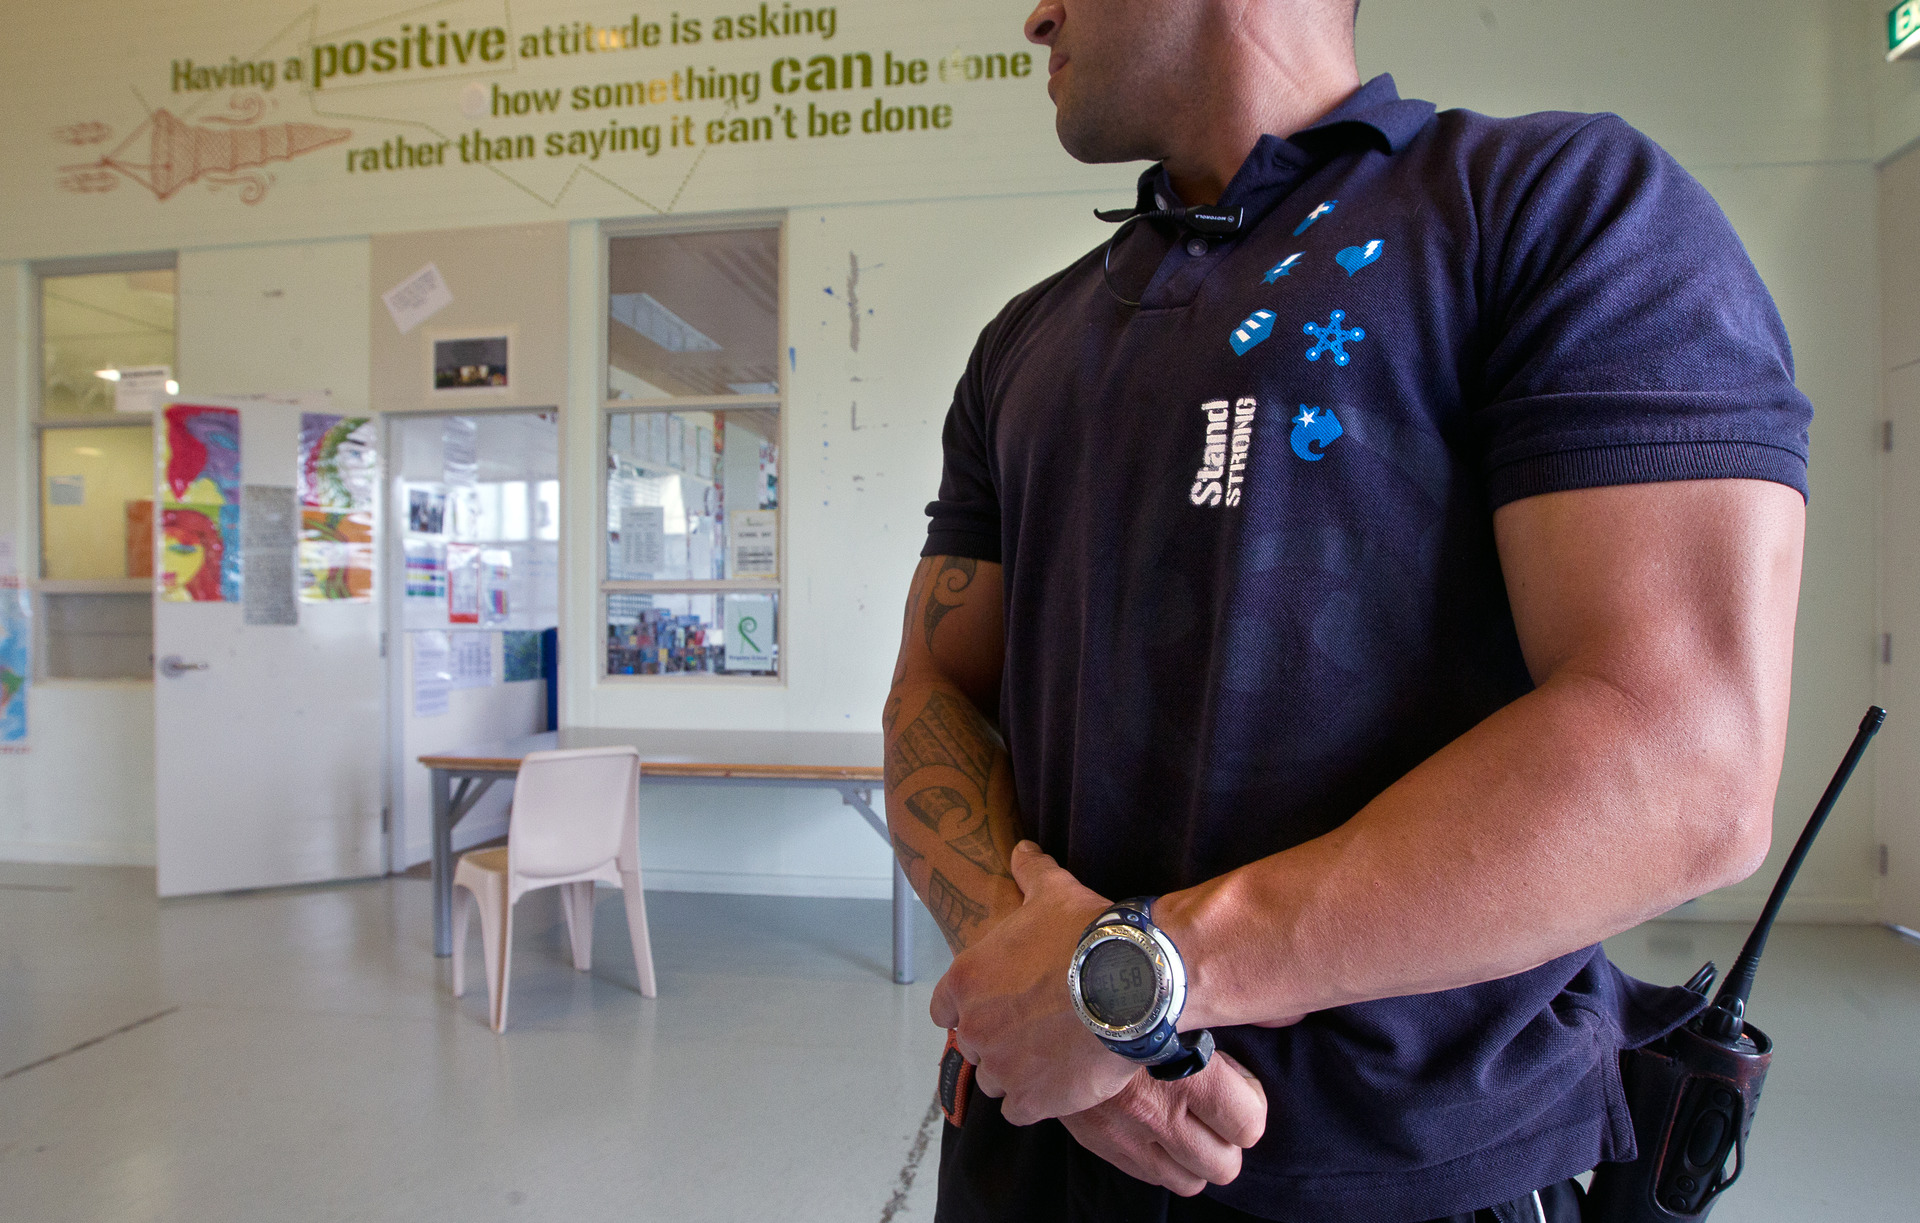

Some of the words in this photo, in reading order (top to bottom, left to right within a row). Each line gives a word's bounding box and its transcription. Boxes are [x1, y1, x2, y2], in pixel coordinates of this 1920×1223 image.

[171, 56, 276, 92] Having
[283, 57, 302, 82] a
[312, 21, 506, 89] positive
[520, 13, 661, 58] attitude
[671, 12, 702, 46] is
[712, 2, 837, 40] asking
[491, 82, 561, 117] how
[571, 66, 760, 111] something
[771, 51, 874, 95] can
[884, 50, 929, 86] be
[346, 133, 446, 173] rather
[458, 129, 535, 164] than
[544, 118, 661, 158] saying
[671, 115, 696, 148] it
[705, 103, 798, 145] can't
[807, 102, 852, 138] be
[861, 98, 953, 135] done
[1189, 400, 1230, 506] Stand
[1225, 396, 1257, 507] STRONG
